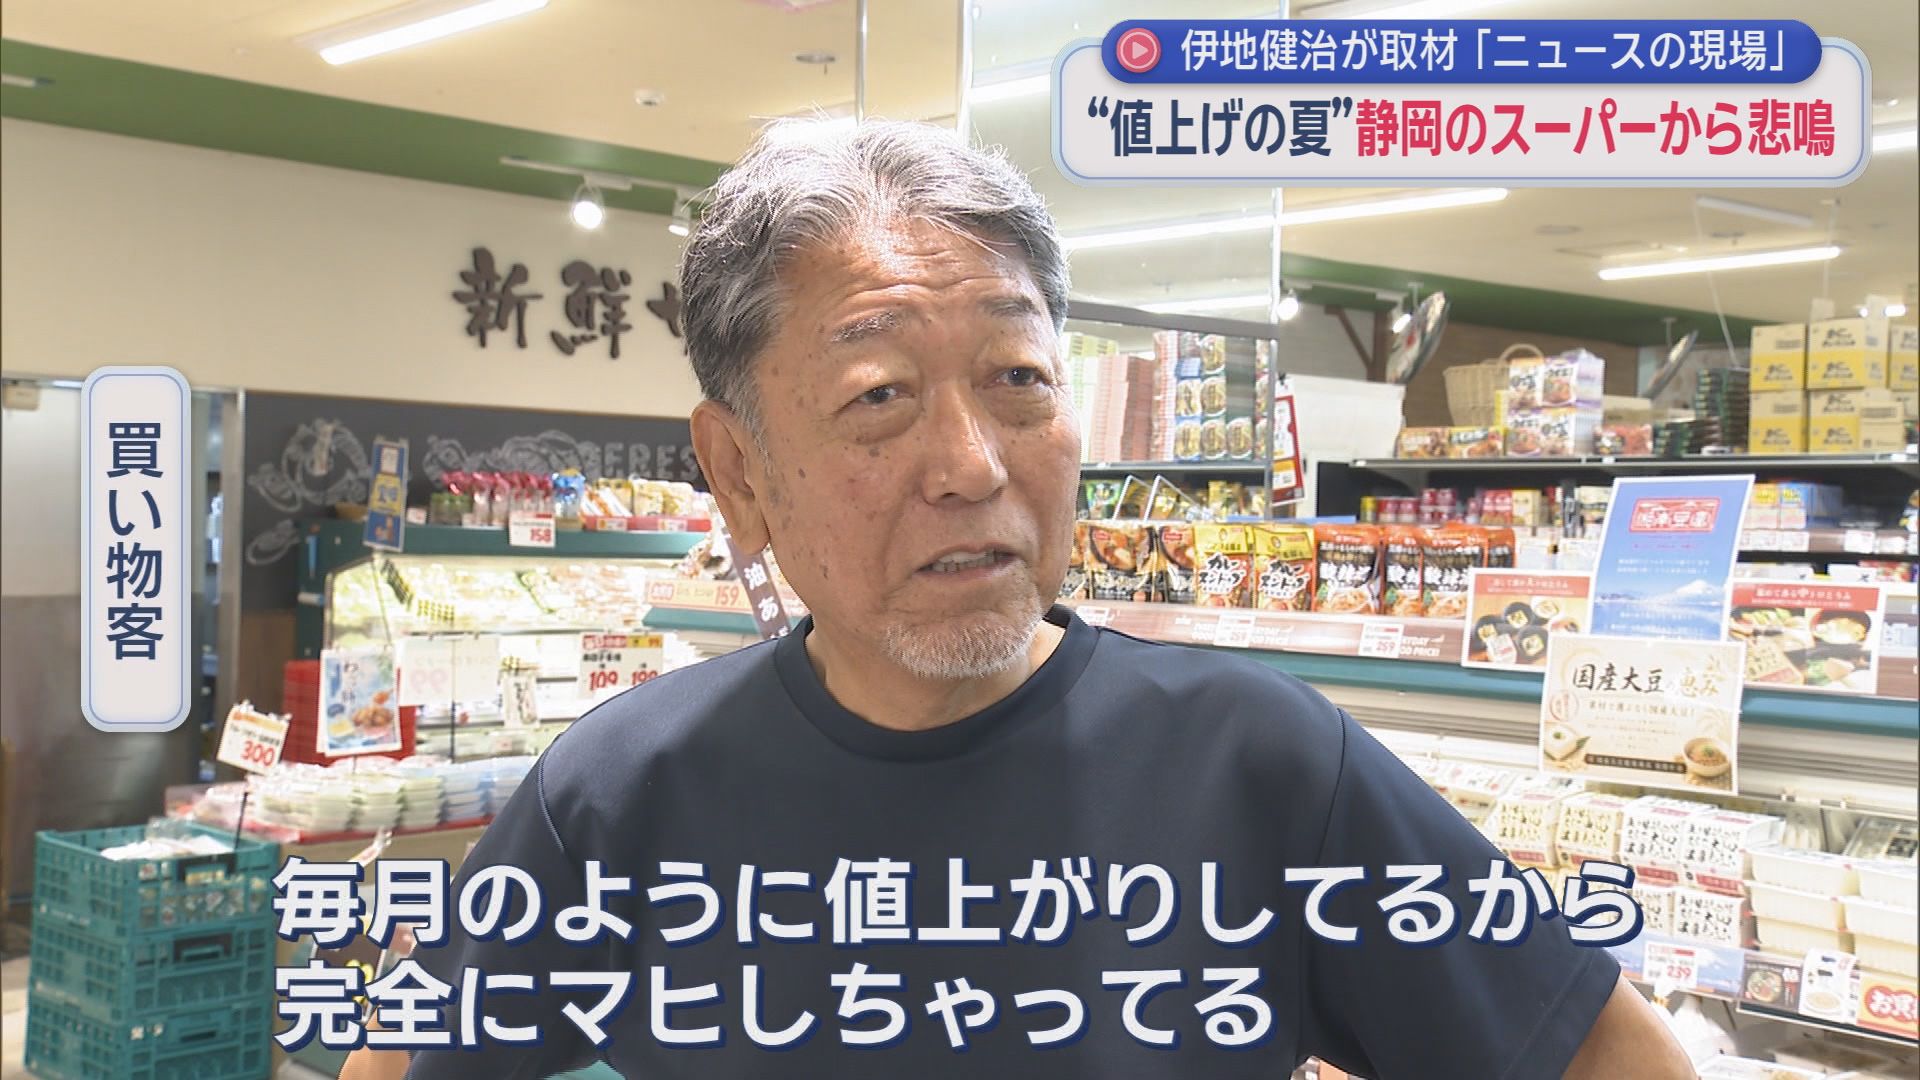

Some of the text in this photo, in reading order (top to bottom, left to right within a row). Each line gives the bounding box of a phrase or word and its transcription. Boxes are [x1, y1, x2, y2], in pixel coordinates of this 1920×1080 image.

[530, 526, 553, 542] 158
[715, 584, 740, 606] 159
[590, 670, 618, 691] 109
[240, 739, 276, 767] 300
[1666, 964, 1692, 980] 239
